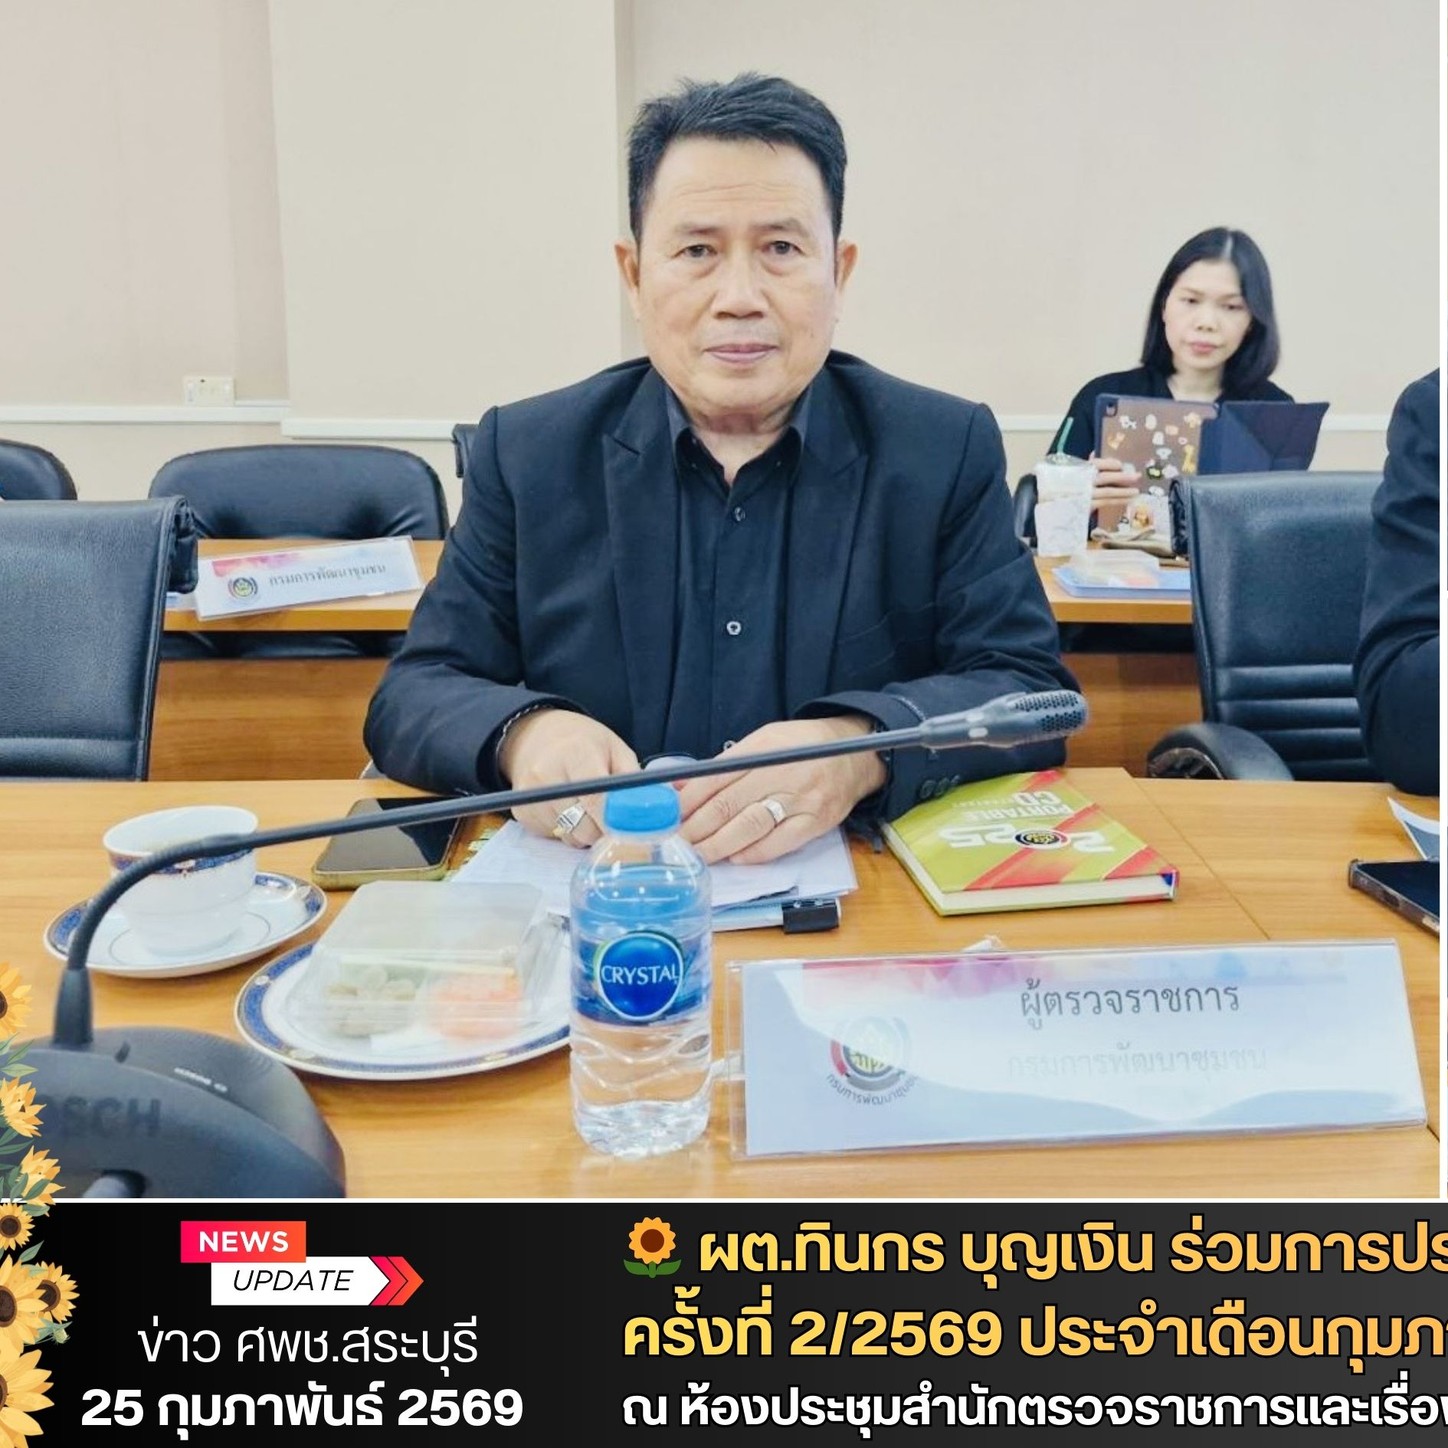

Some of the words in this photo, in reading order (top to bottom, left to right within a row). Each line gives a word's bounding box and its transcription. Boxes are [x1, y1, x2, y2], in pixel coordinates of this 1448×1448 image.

[600, 963, 679, 985] CRYSTAL
[1019, 977, 1241, 1030] ผู้ตรวจราชการ
